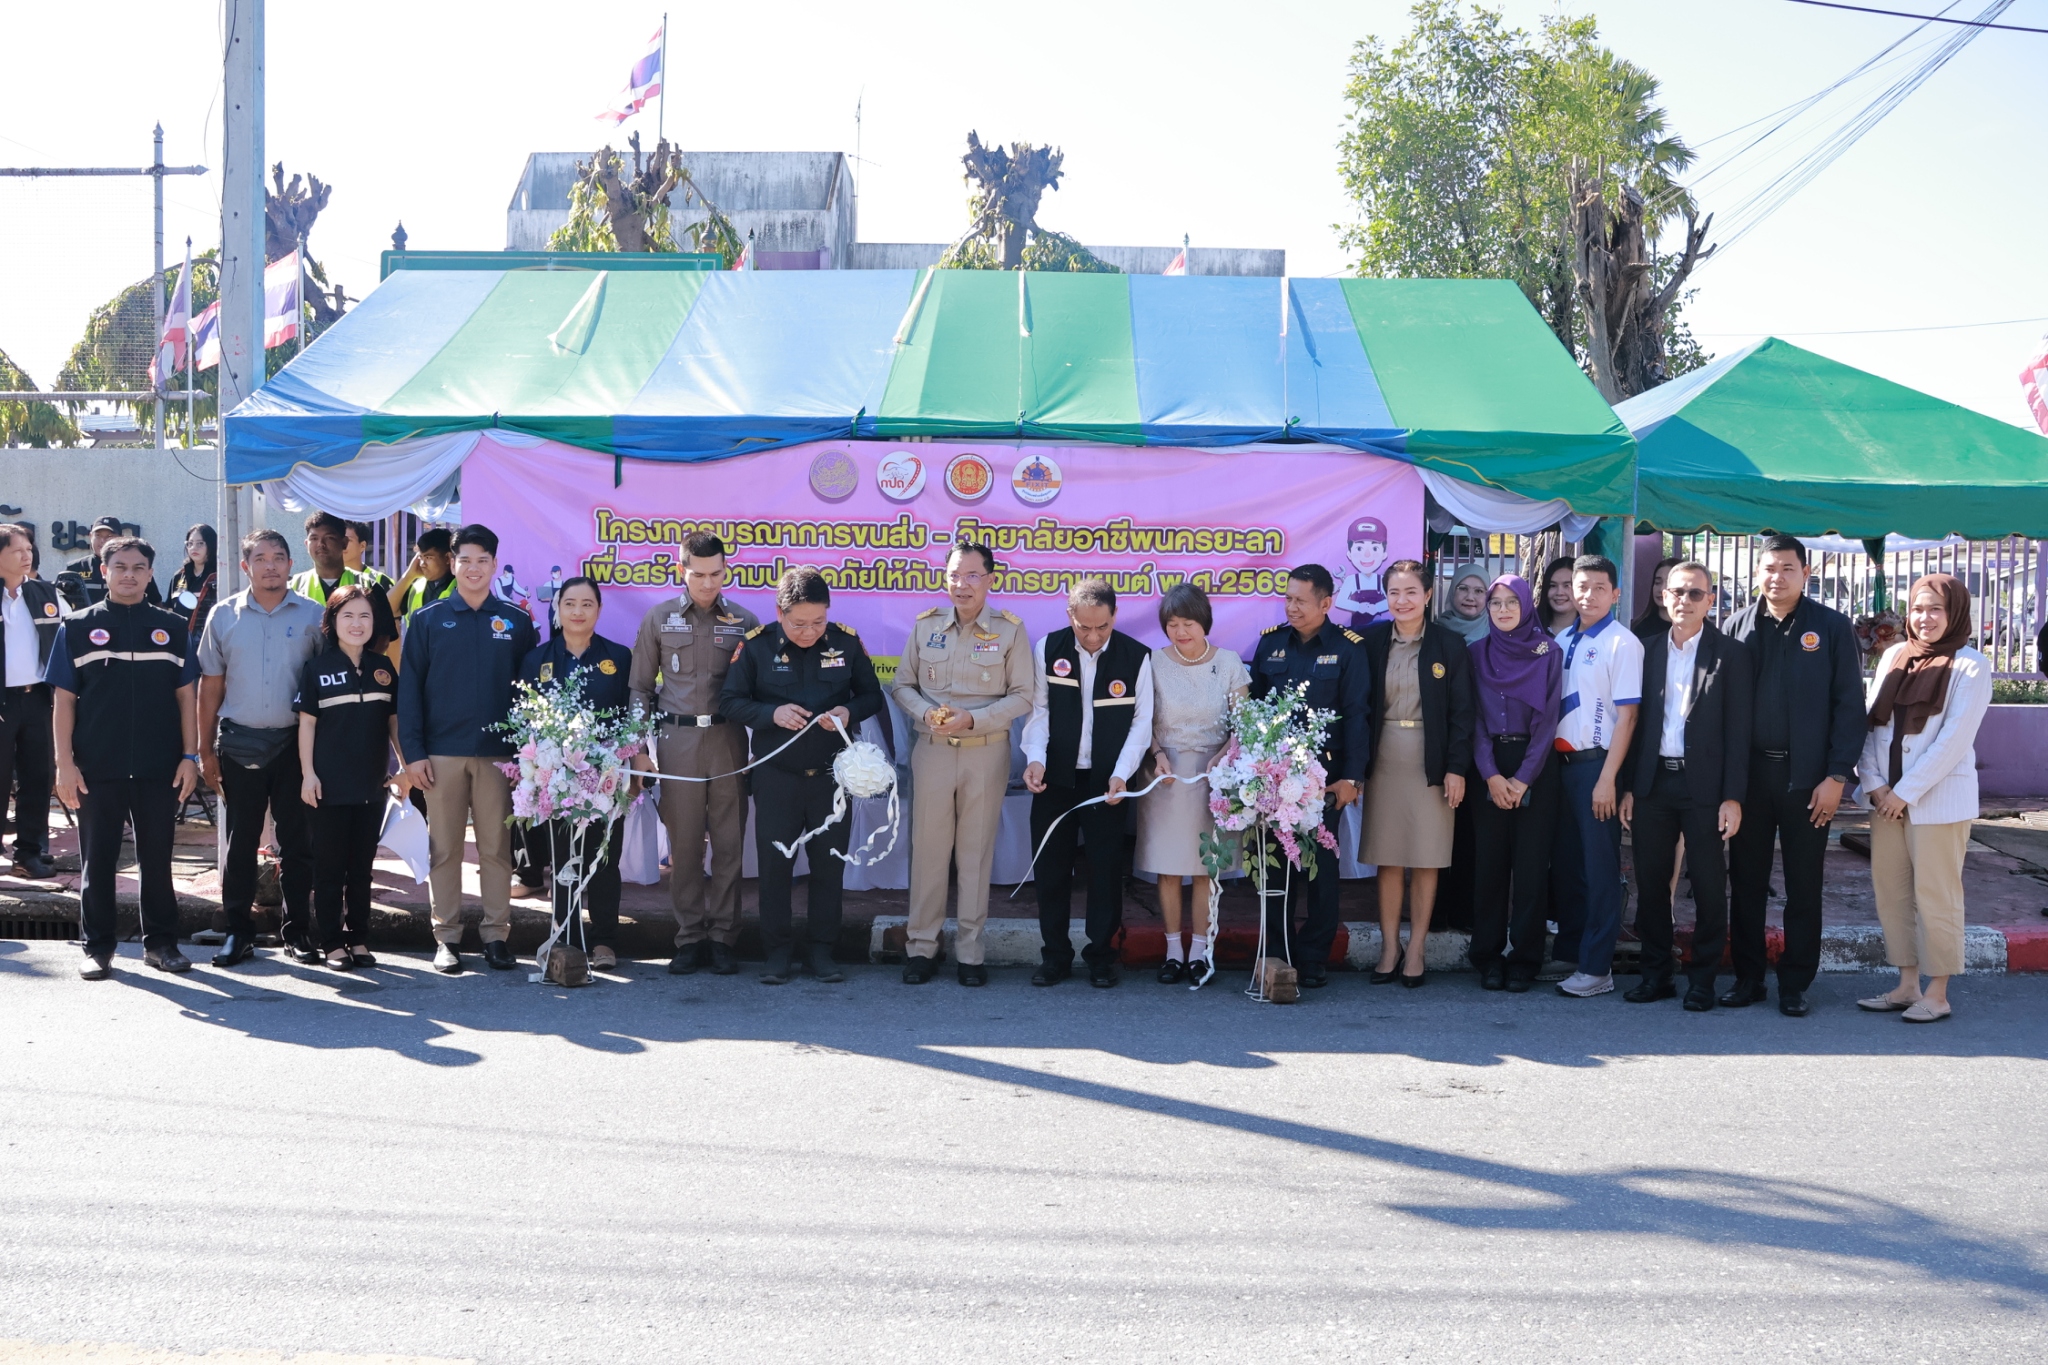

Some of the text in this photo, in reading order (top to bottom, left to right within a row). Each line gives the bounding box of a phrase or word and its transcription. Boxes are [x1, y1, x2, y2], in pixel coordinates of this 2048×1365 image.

[1158, 571, 1289, 593] พศ.2569
[873, 663, 898, 673] rive
[319, 671, 348, 686] DLT
